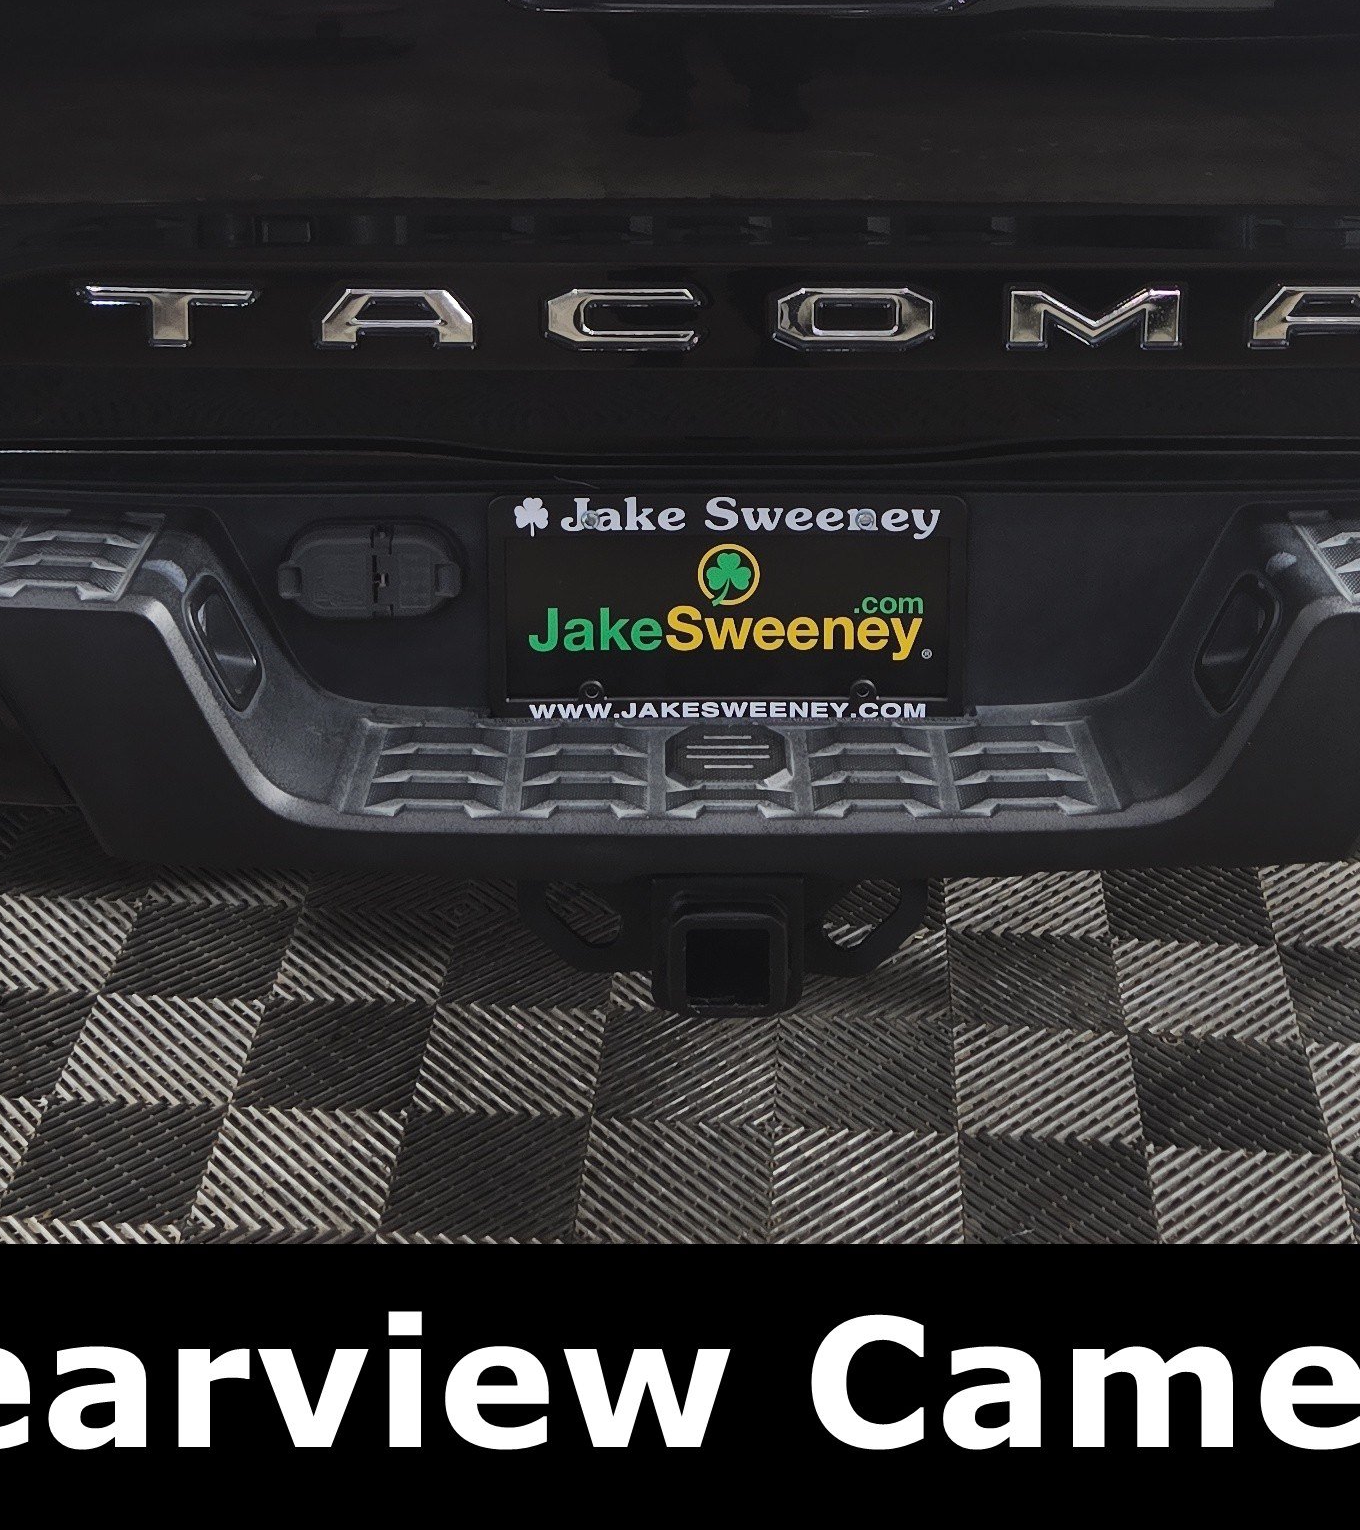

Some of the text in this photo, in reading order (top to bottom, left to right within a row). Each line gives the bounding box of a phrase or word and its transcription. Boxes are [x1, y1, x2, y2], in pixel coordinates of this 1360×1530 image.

[561, 497, 941, 540] Jake Sweeney
[529, 701, 926, 719] WWW.JAKESWEENEY.COM
